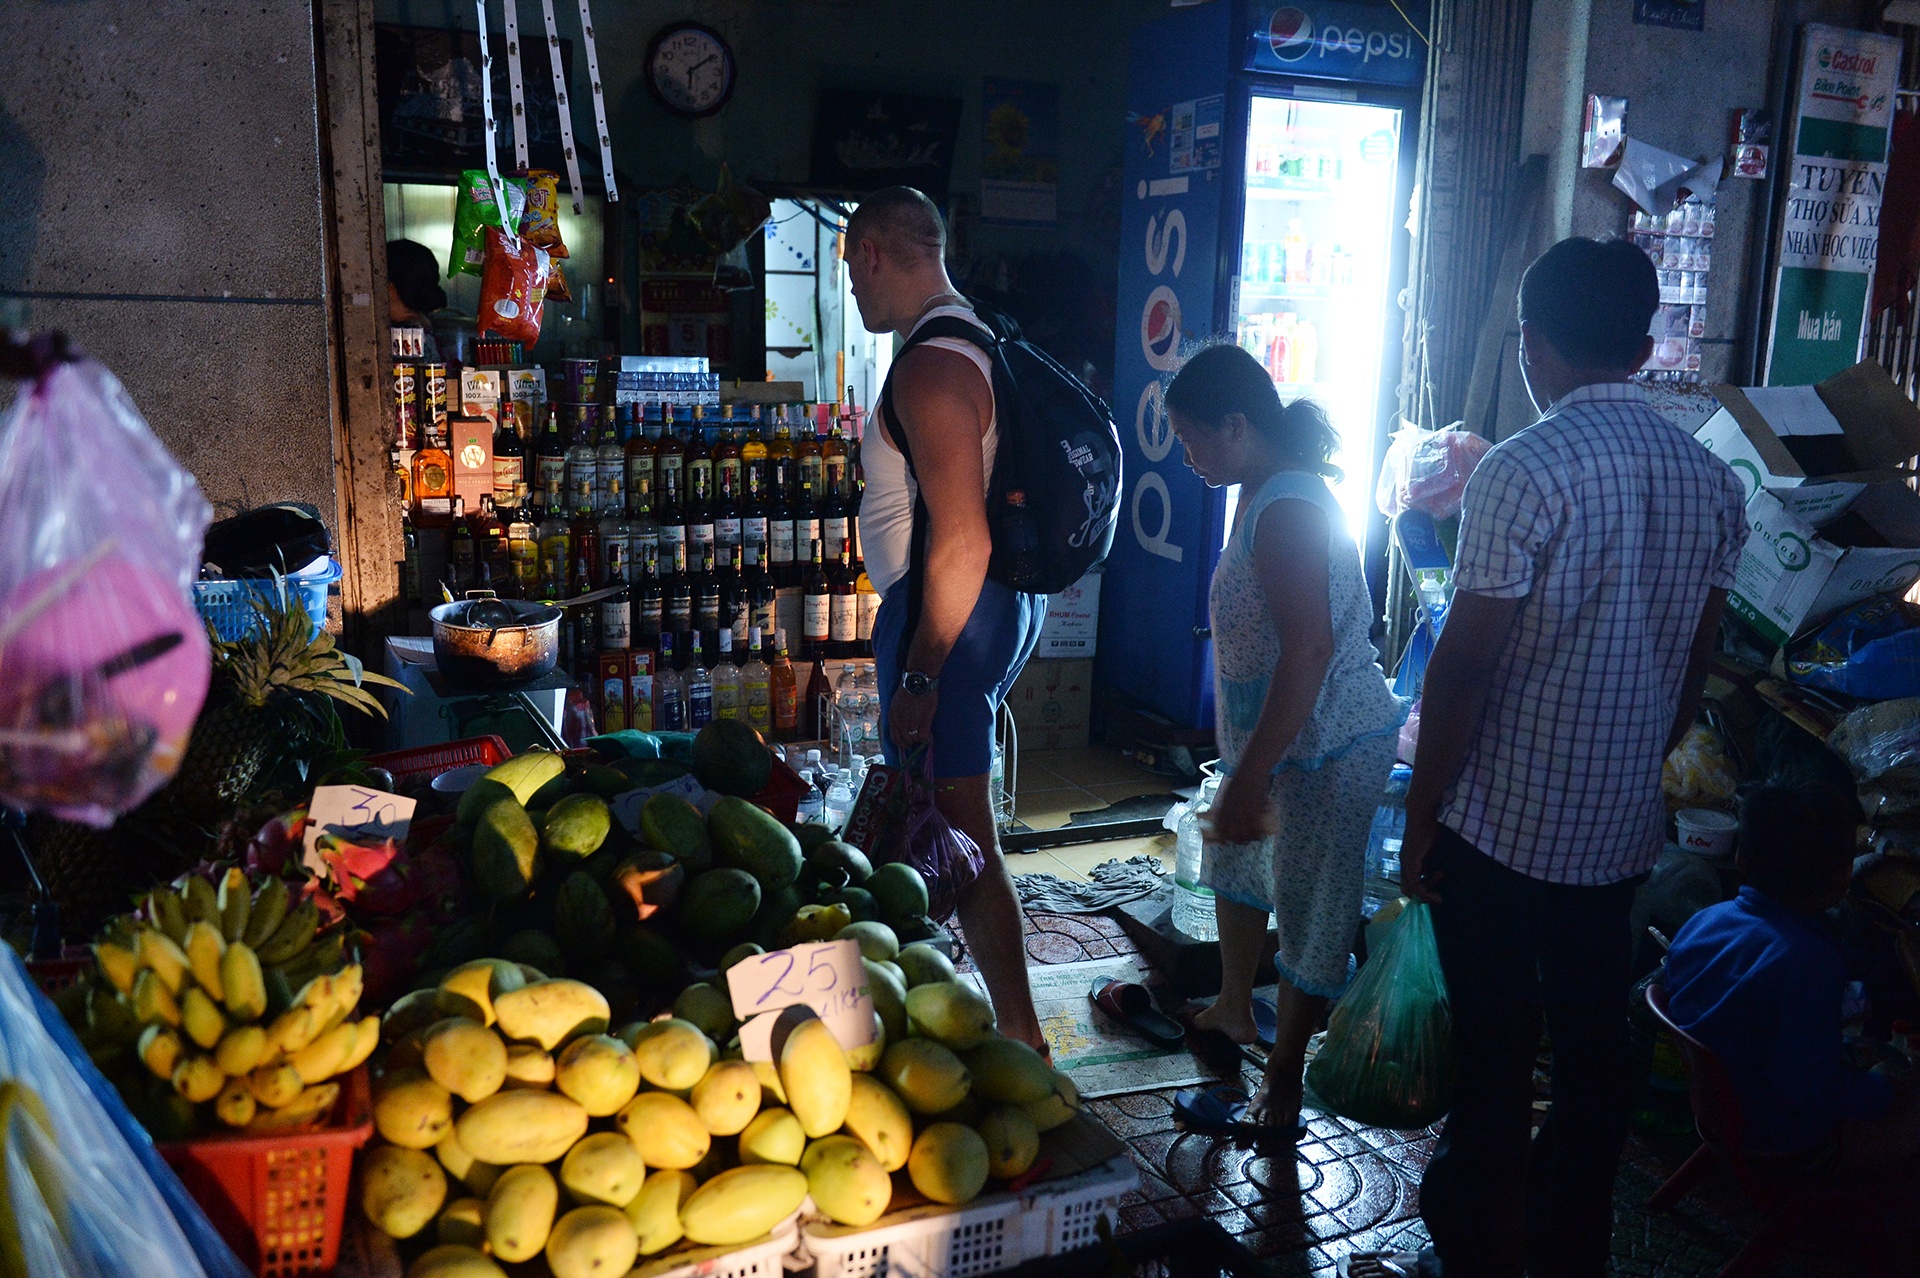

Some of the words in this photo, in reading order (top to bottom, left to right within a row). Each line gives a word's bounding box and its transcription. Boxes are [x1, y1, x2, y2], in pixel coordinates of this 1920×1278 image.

[1319, 25, 1411, 63] pepsi
[1831, 49, 1877, 74] Castrol
[1813, 78, 1835, 91] Bike
[1836, 81, 1861, 97] Point
[1793, 198, 1830, 227] THỢ
[1829, 197, 1860, 225] SỬA
[1821, 234, 1849, 263] HỌC
[1797, 310, 1820, 340] Mua
[1821, 311, 1842, 341] bán
[1132, 177, 1189, 563] pepsi
[1049, 610, 1070, 618] RHUM
[341, 787, 397, 833] 30
[756, 945, 838, 1006] 25
